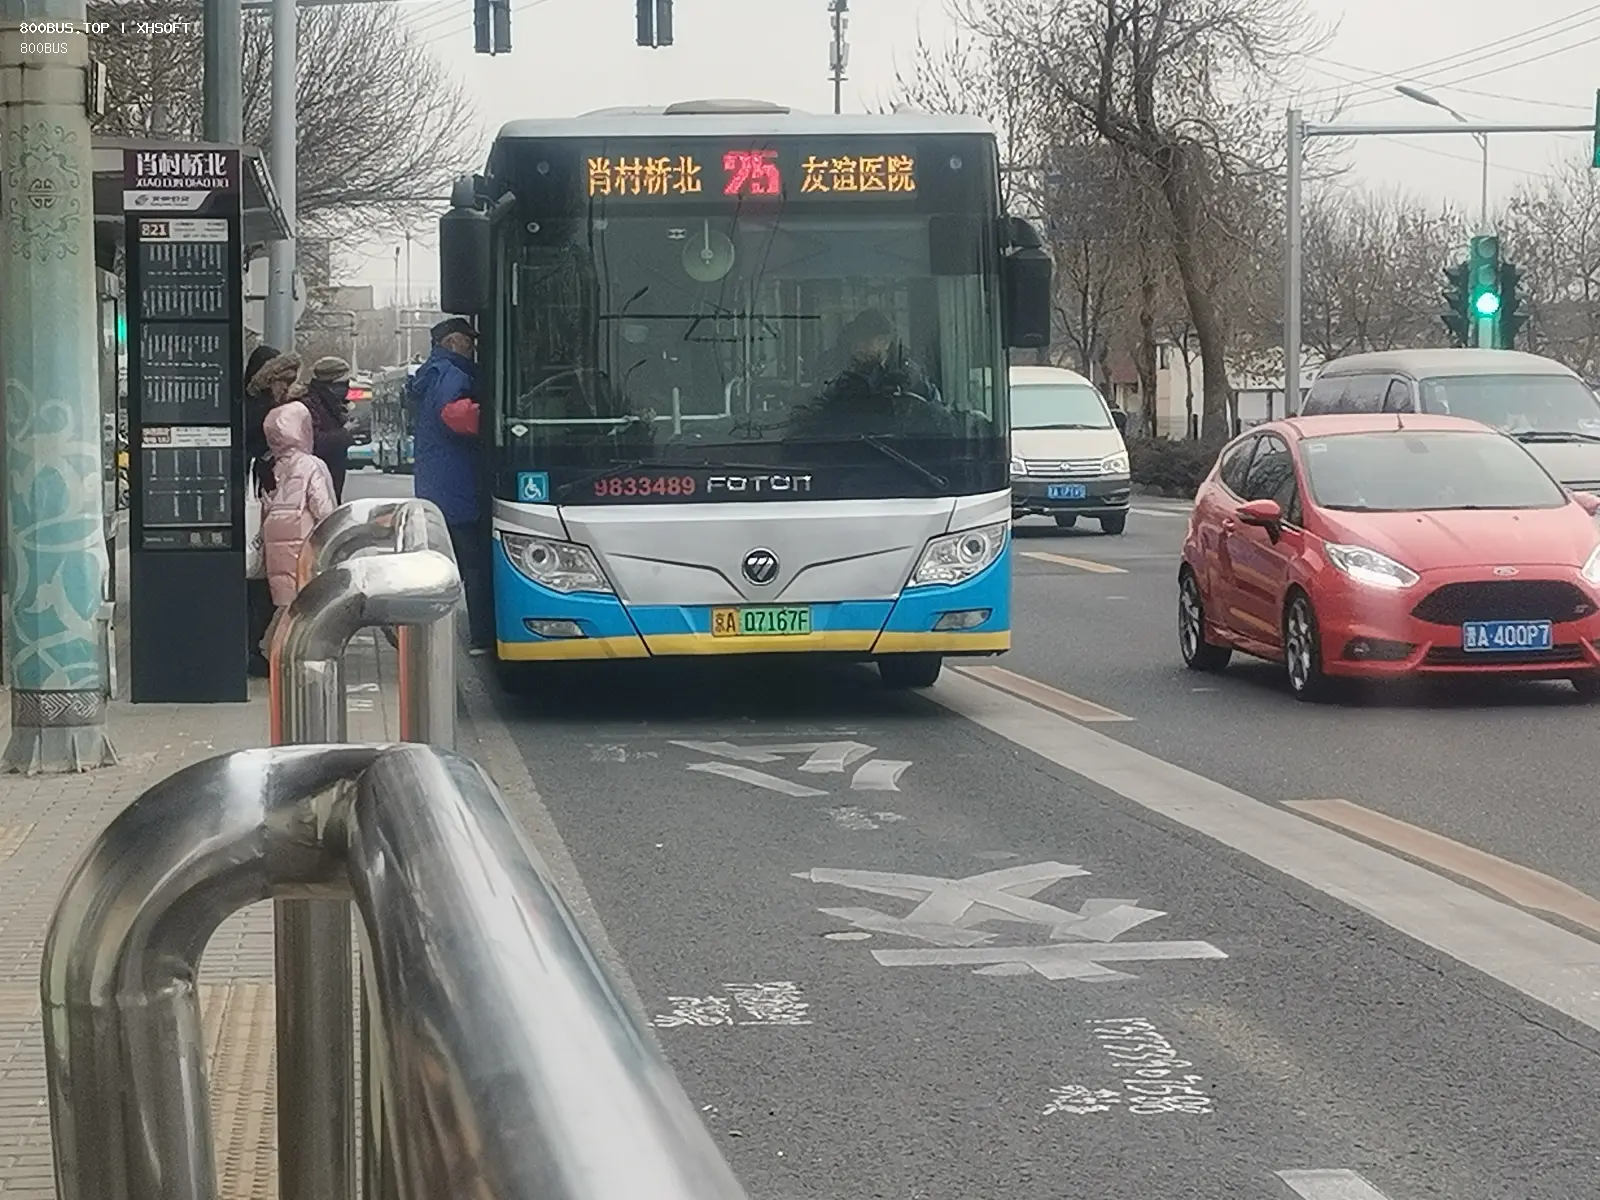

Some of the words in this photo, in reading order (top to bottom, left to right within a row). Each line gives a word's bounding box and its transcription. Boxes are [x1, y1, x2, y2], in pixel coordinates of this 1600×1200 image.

[136, 152, 228, 177] 肖村桥北
[587, 155, 703, 196] 肖村桥北
[800, 154, 916, 195] 友谊医院
[141, 223, 168, 237] 821
[594, 475, 696, 497] 9833489
[706, 475, 813, 493] FOTON
